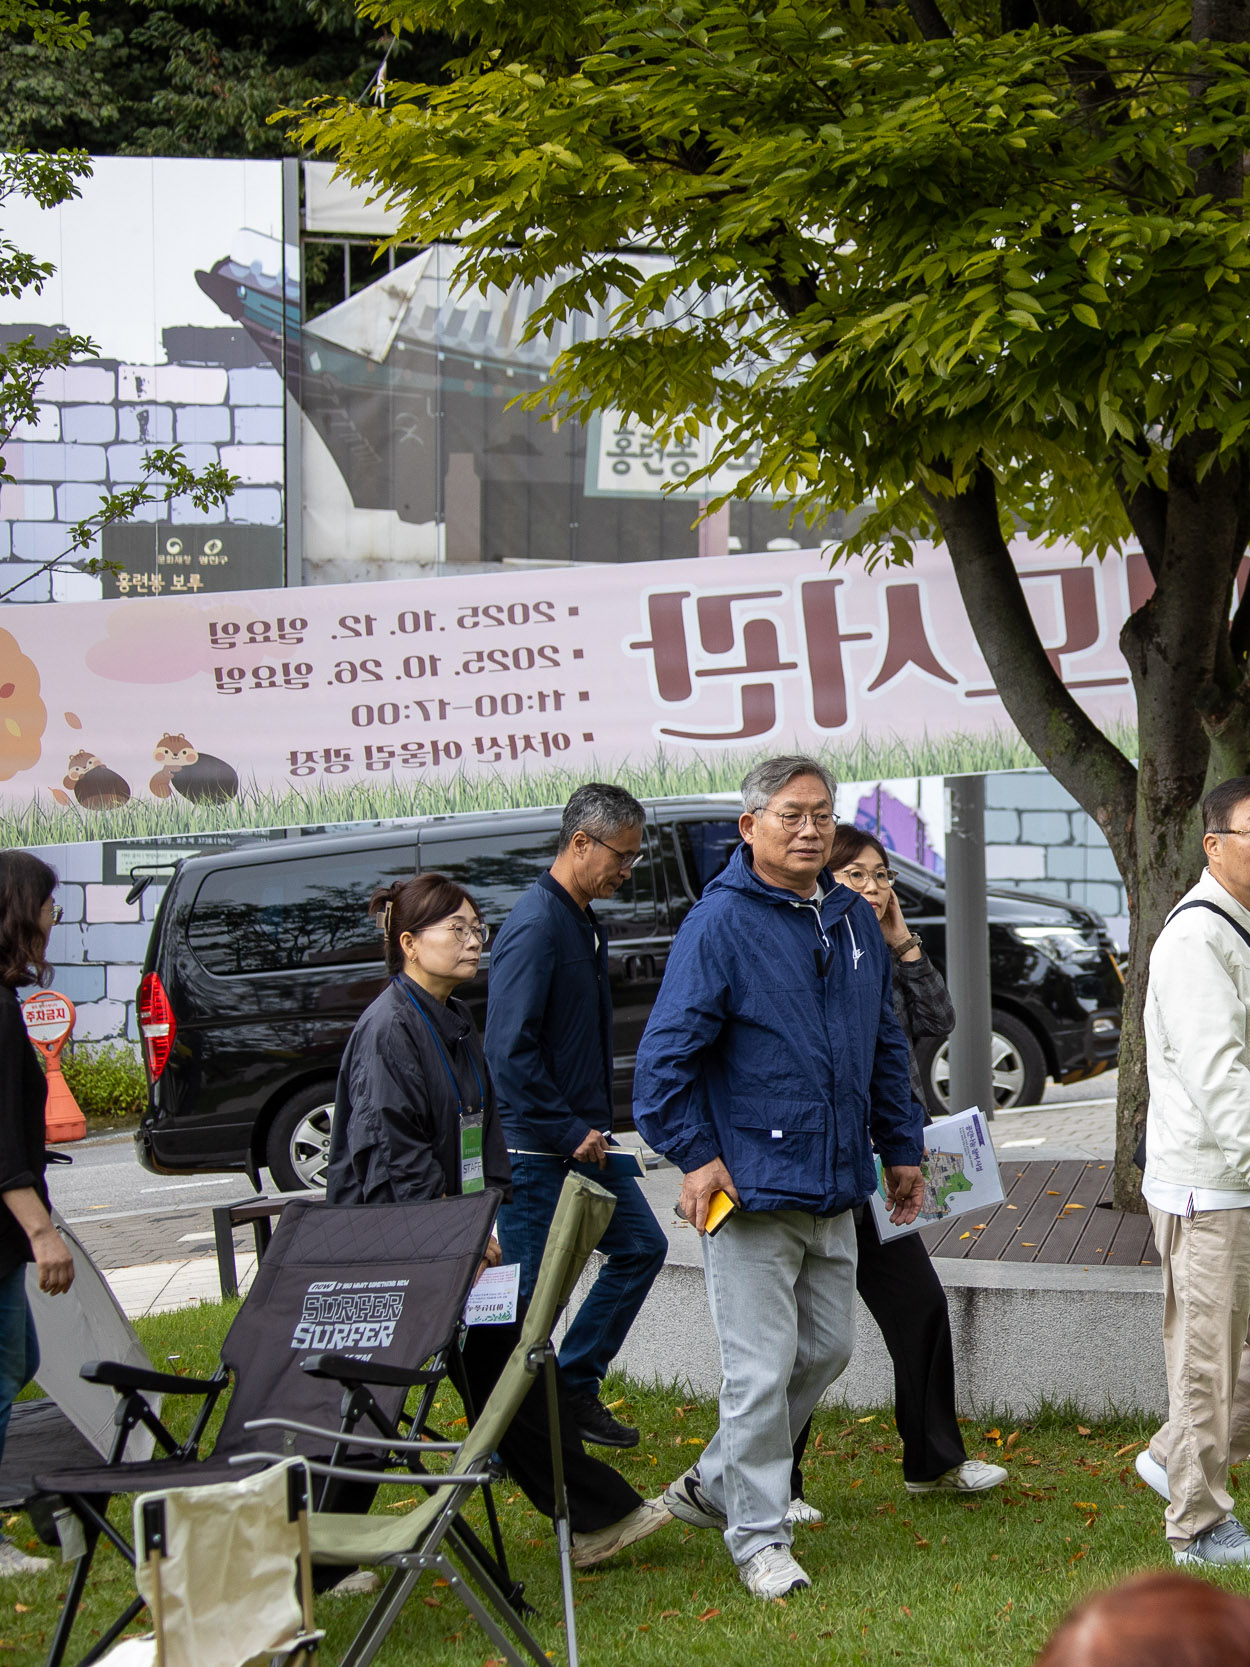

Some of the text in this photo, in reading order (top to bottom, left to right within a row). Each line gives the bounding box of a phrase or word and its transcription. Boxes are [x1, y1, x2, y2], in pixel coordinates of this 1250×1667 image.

[116, 572, 204, 593] 홍련봉 보루
[26, 1008, 65, 1022] 주차금지
[463, 1161, 481, 1174] STAFF
[301, 1292, 404, 1323] SURFER
[290, 1321, 397, 1350] SURFER
